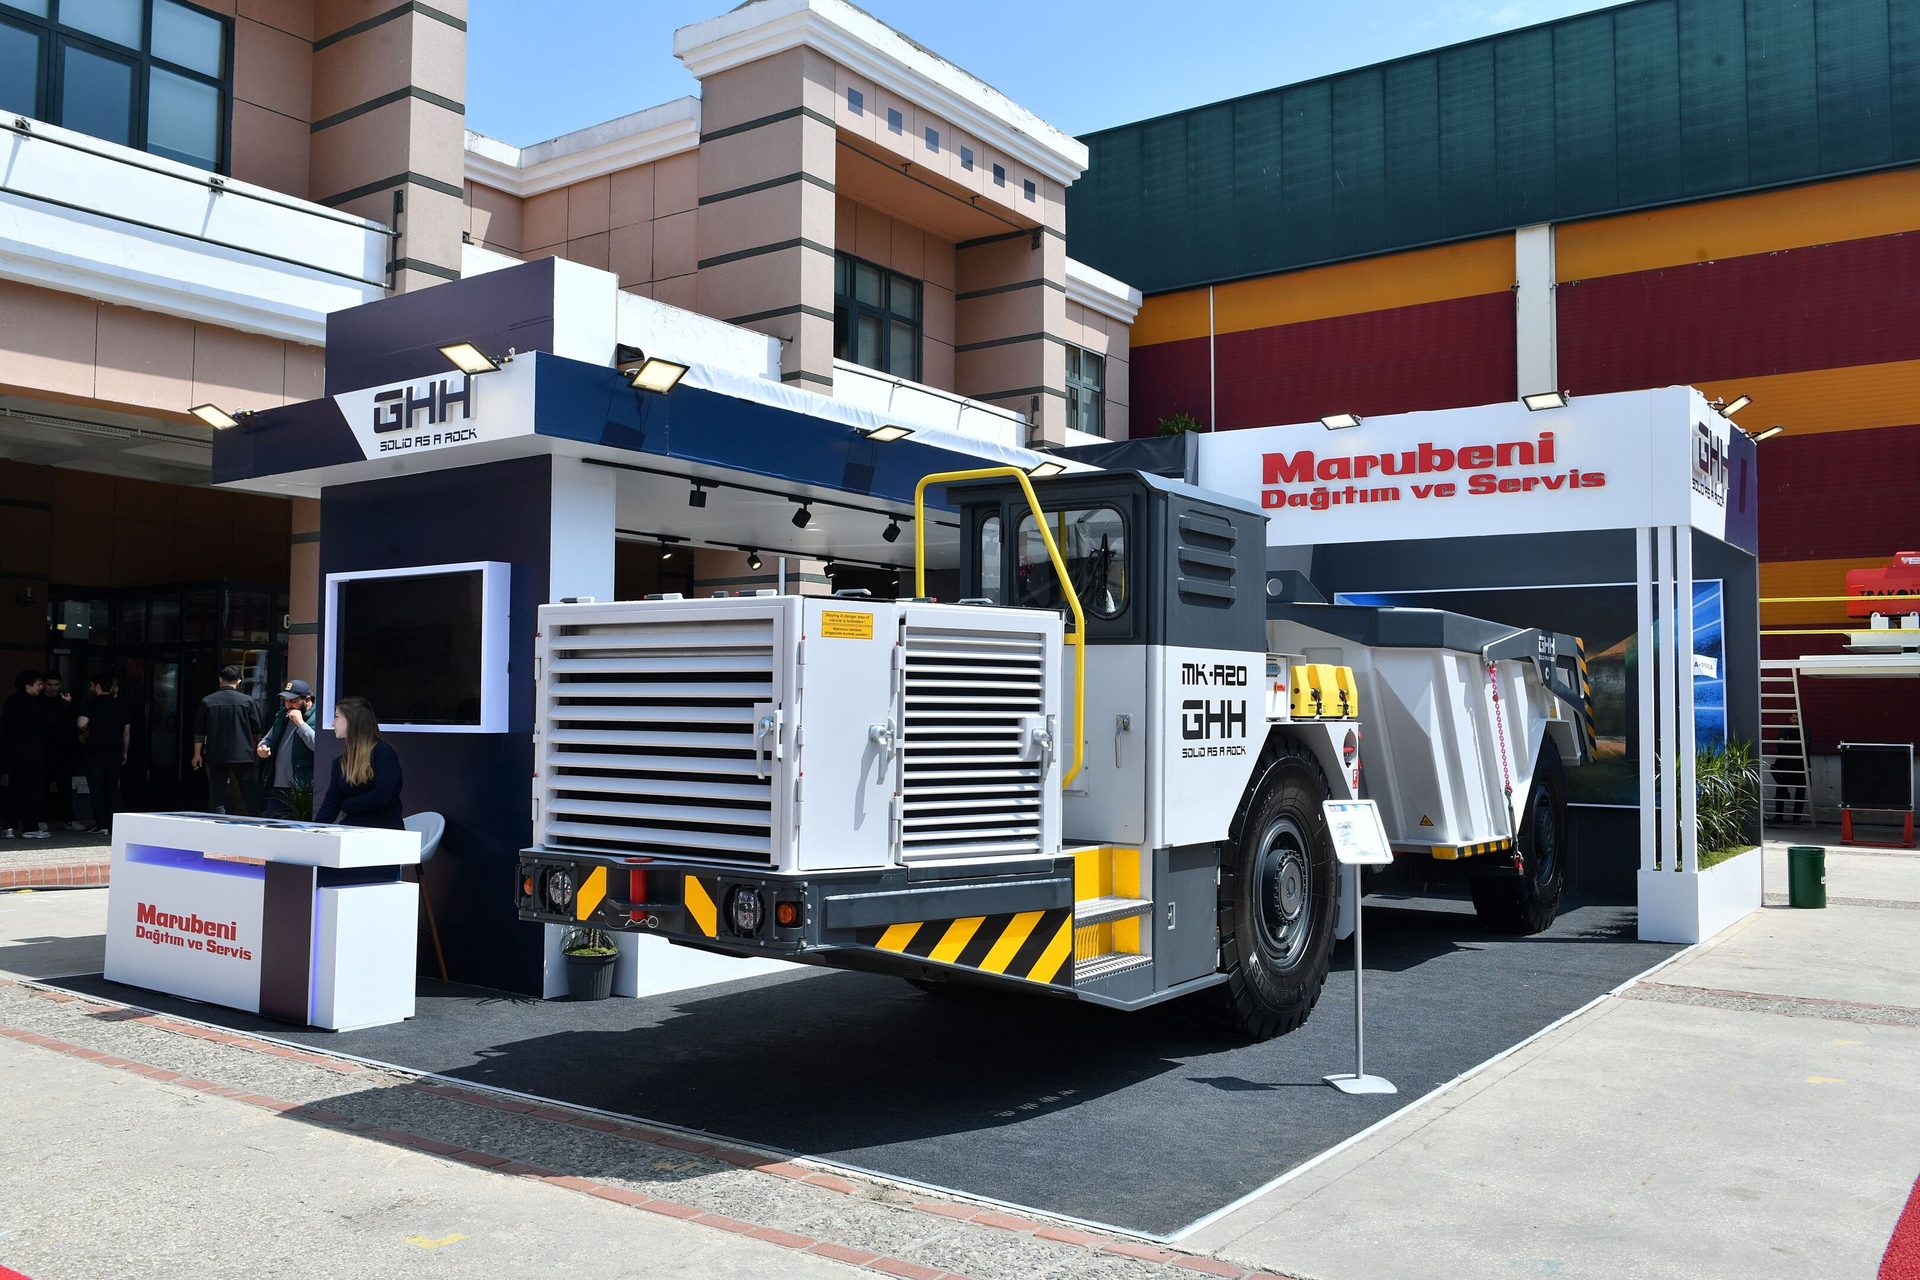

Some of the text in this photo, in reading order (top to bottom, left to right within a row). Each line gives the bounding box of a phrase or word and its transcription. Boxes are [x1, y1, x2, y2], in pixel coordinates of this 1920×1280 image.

[374, 375, 471, 434] GHH
[415, 435, 430, 447] AS
[433, 433, 441, 445] A
[445, 428, 478, 443] ROCK
[1261, 431, 1556, 485] Marubeni
[1261, 469, 1606, 511] Dağıtım ve Servis
[1538, 635, 1556, 655] GHH
[285, 682, 293, 691] B
[1182, 699, 1246, 740] GHH
[1207, 746, 1218, 756] AS
[1219, 746, 1225, 755] A
[1226, 745, 1246, 755] ROCK
[137, 902, 237, 941] Marubeni
[135, 925, 252, 961] Dağıtım ve Servis
